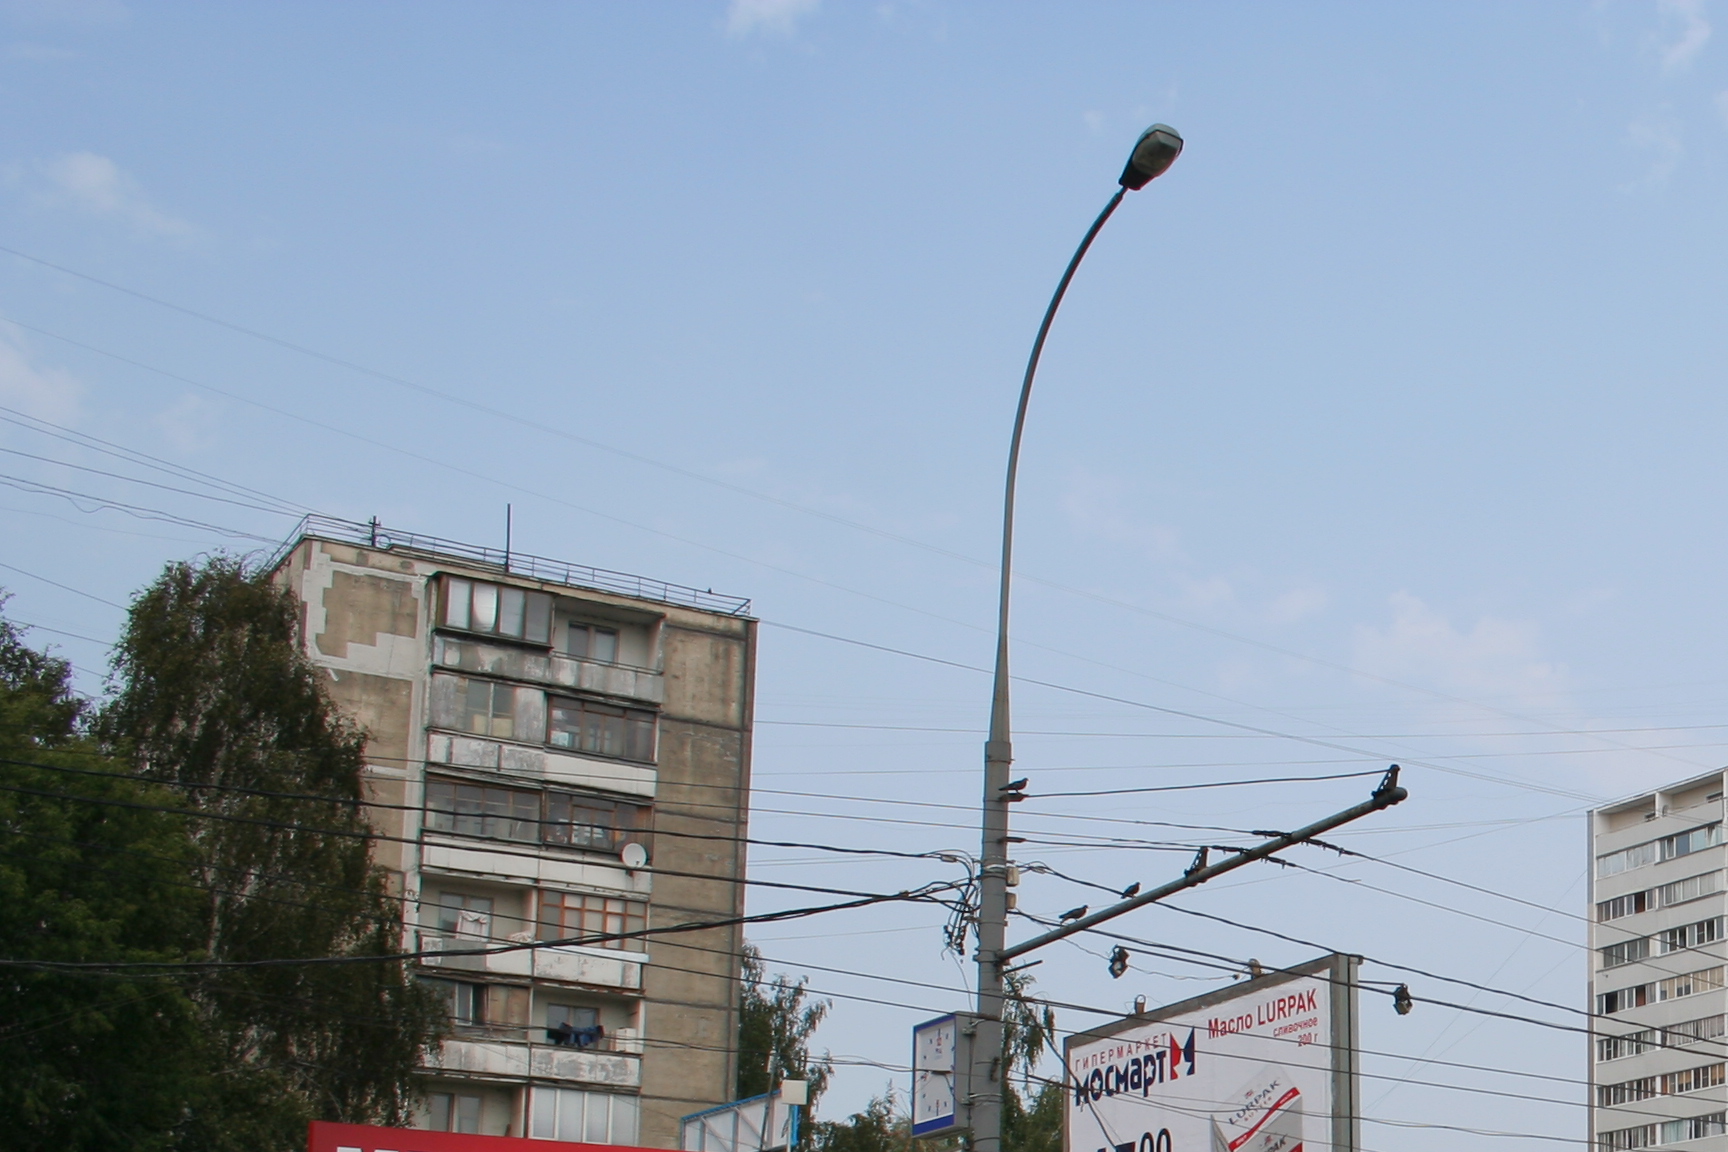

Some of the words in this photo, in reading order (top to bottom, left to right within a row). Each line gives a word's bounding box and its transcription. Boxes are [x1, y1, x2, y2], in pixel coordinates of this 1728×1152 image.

[1208, 1014, 1253, 1039] Масло
[1258, 988, 1317, 1025] LURPAK
[1075, 1033, 1167, 1072] ГИПЕРМАРКЕТ
[1229, 1080, 1280, 1125] LURPAK
